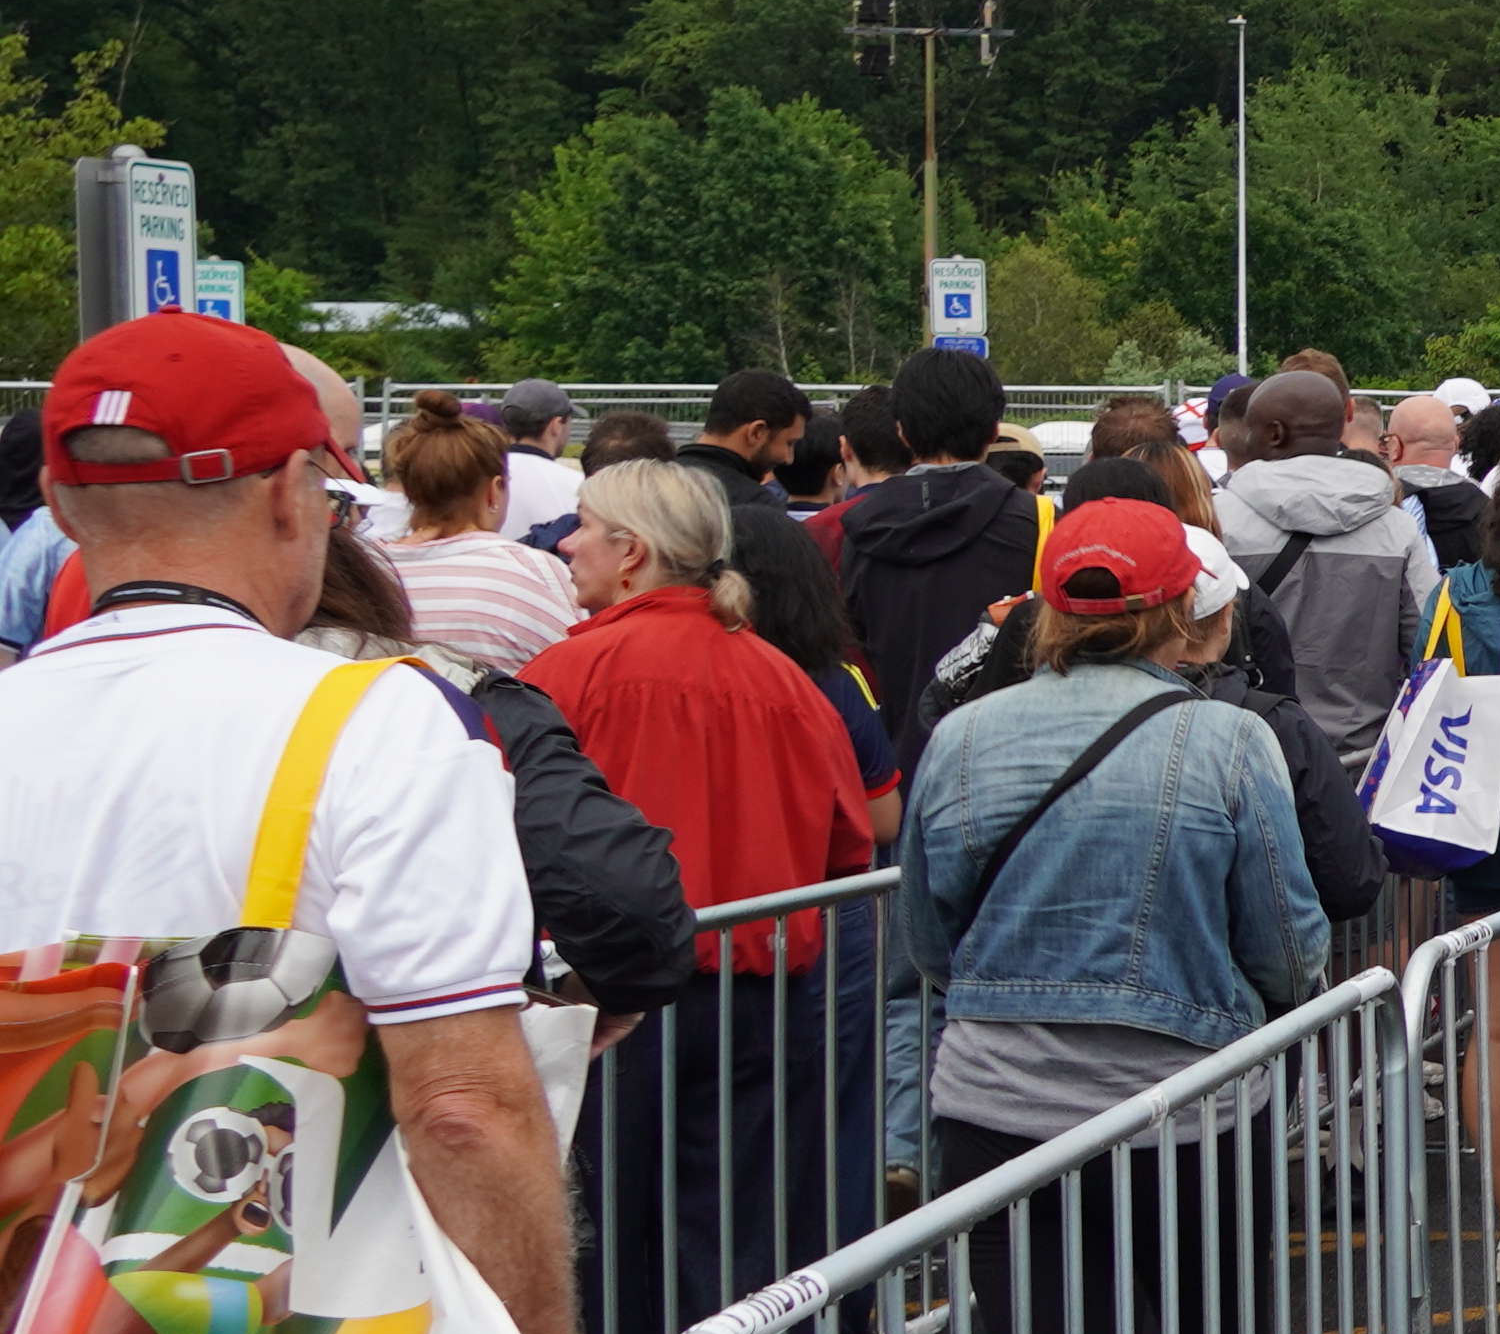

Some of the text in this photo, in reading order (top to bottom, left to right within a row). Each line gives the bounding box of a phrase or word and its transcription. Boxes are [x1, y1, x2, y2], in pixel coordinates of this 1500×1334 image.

[134, 179, 189, 208] RESERVED
[140, 214, 185, 241] PARKING
[934, 267, 981, 278] RESERVED
[939, 280, 976, 289] PARKING
[1415, 703, 1473, 815] VISA
